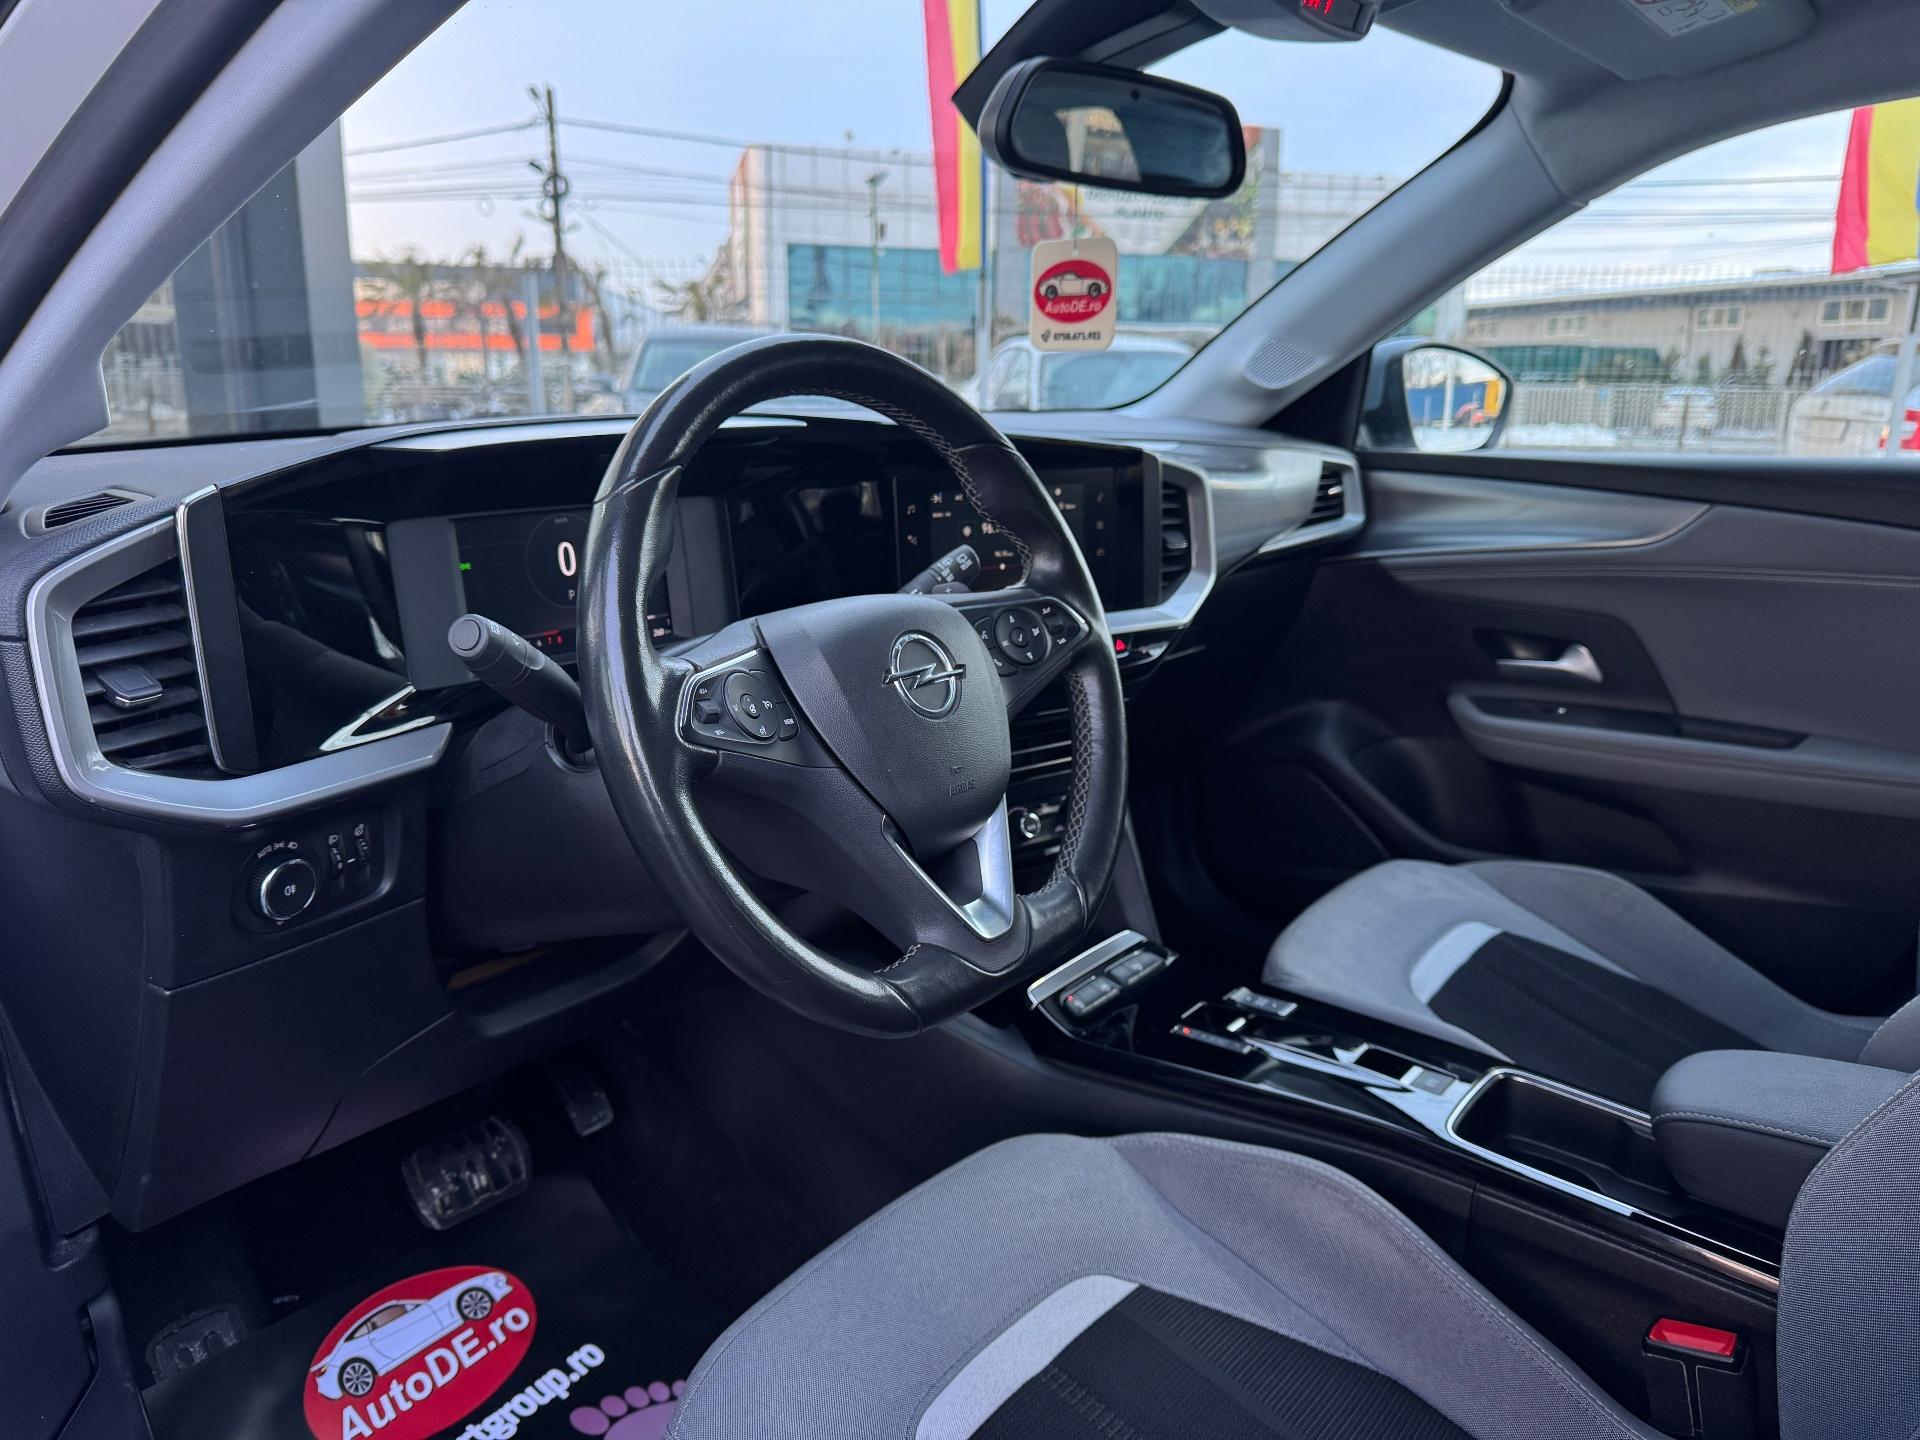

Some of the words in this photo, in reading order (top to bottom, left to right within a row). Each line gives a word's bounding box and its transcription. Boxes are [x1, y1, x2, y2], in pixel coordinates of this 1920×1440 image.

[1045, 300, 1102, 314] AutoDE.ro
[558, 542, 576, 576] 0
[257, 845, 272, 858] AUTO
[342, 1307, 530, 1440] AutoDE.ro
